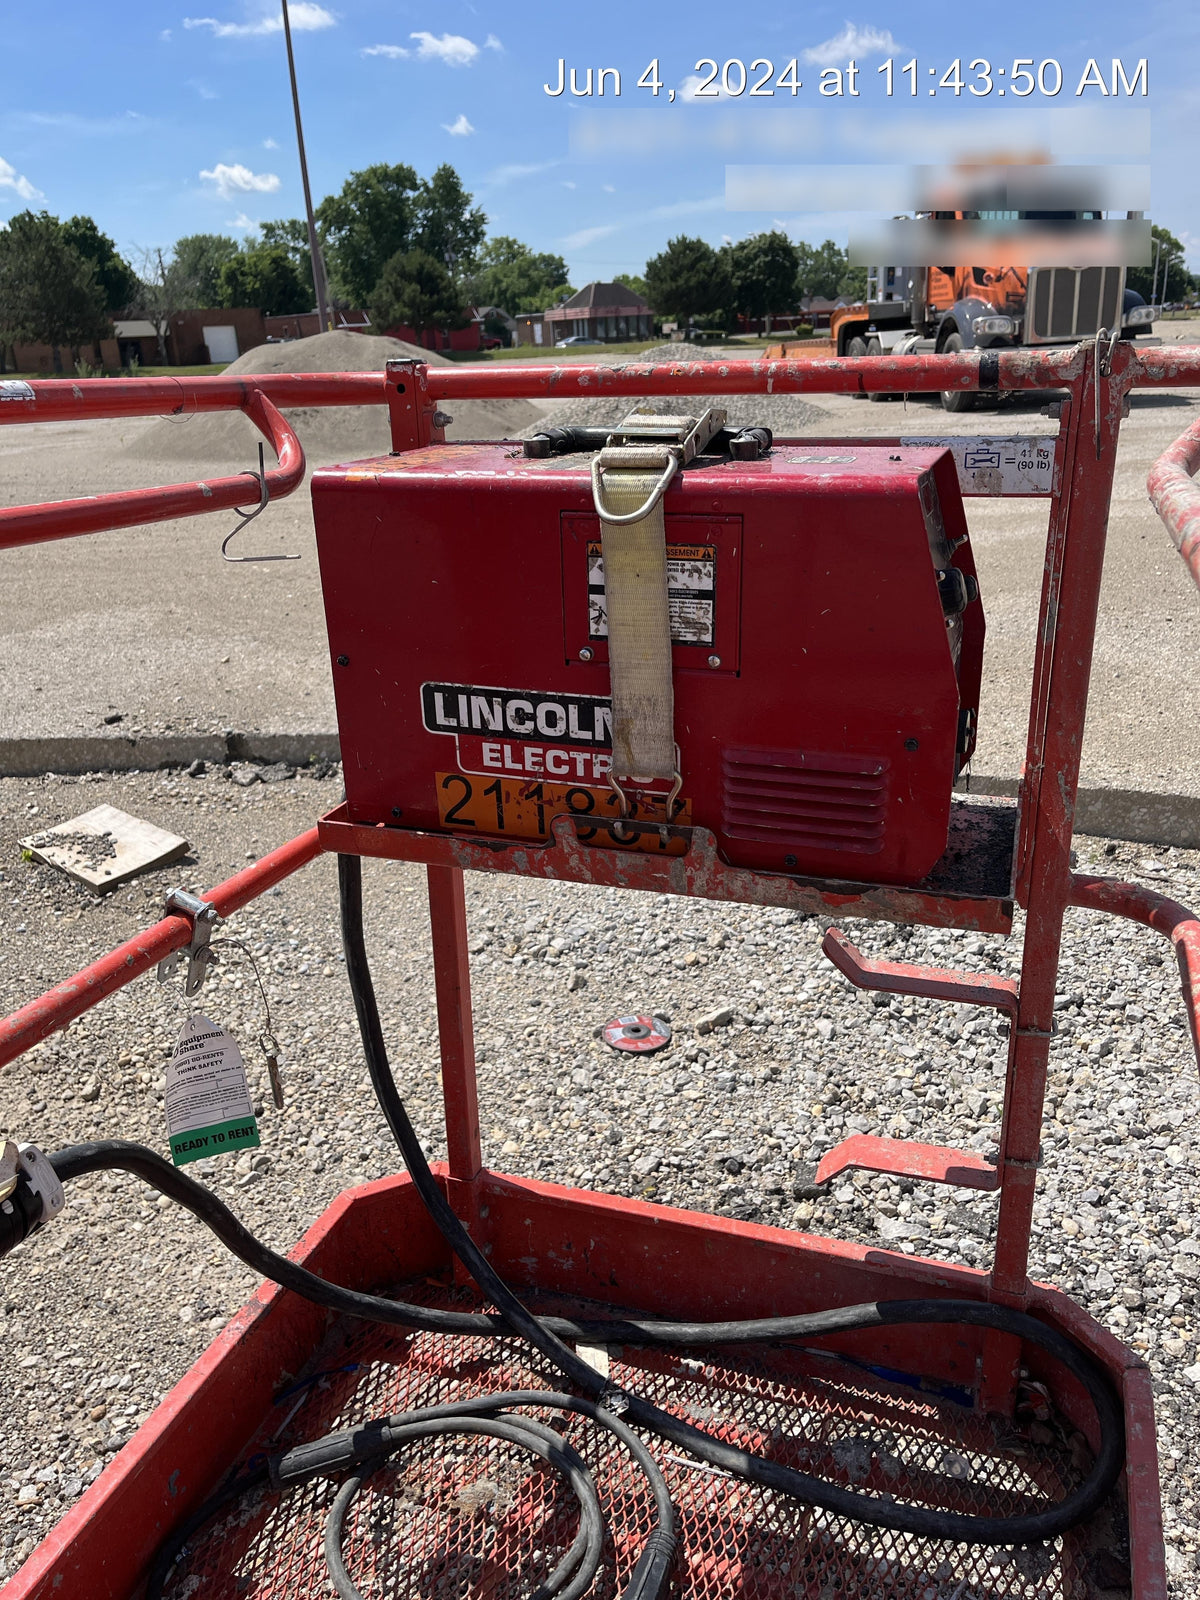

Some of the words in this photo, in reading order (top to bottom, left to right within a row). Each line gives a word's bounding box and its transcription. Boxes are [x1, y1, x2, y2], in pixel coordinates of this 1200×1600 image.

[1017, 460, 1034, 472] (90
[1036, 460, 1051, 472] lb)
[666, 548, 700, 557] SSEMENT
[482, 742, 654, 783] ELECTR
[177, 1065, 198, 1076] THINK
[198, 1059, 223, 1070] SAFETY
[174, 1136, 209, 1155] READY
[211, 1132, 225, 1144] TO
[228, 1126, 255, 1139] RENT
